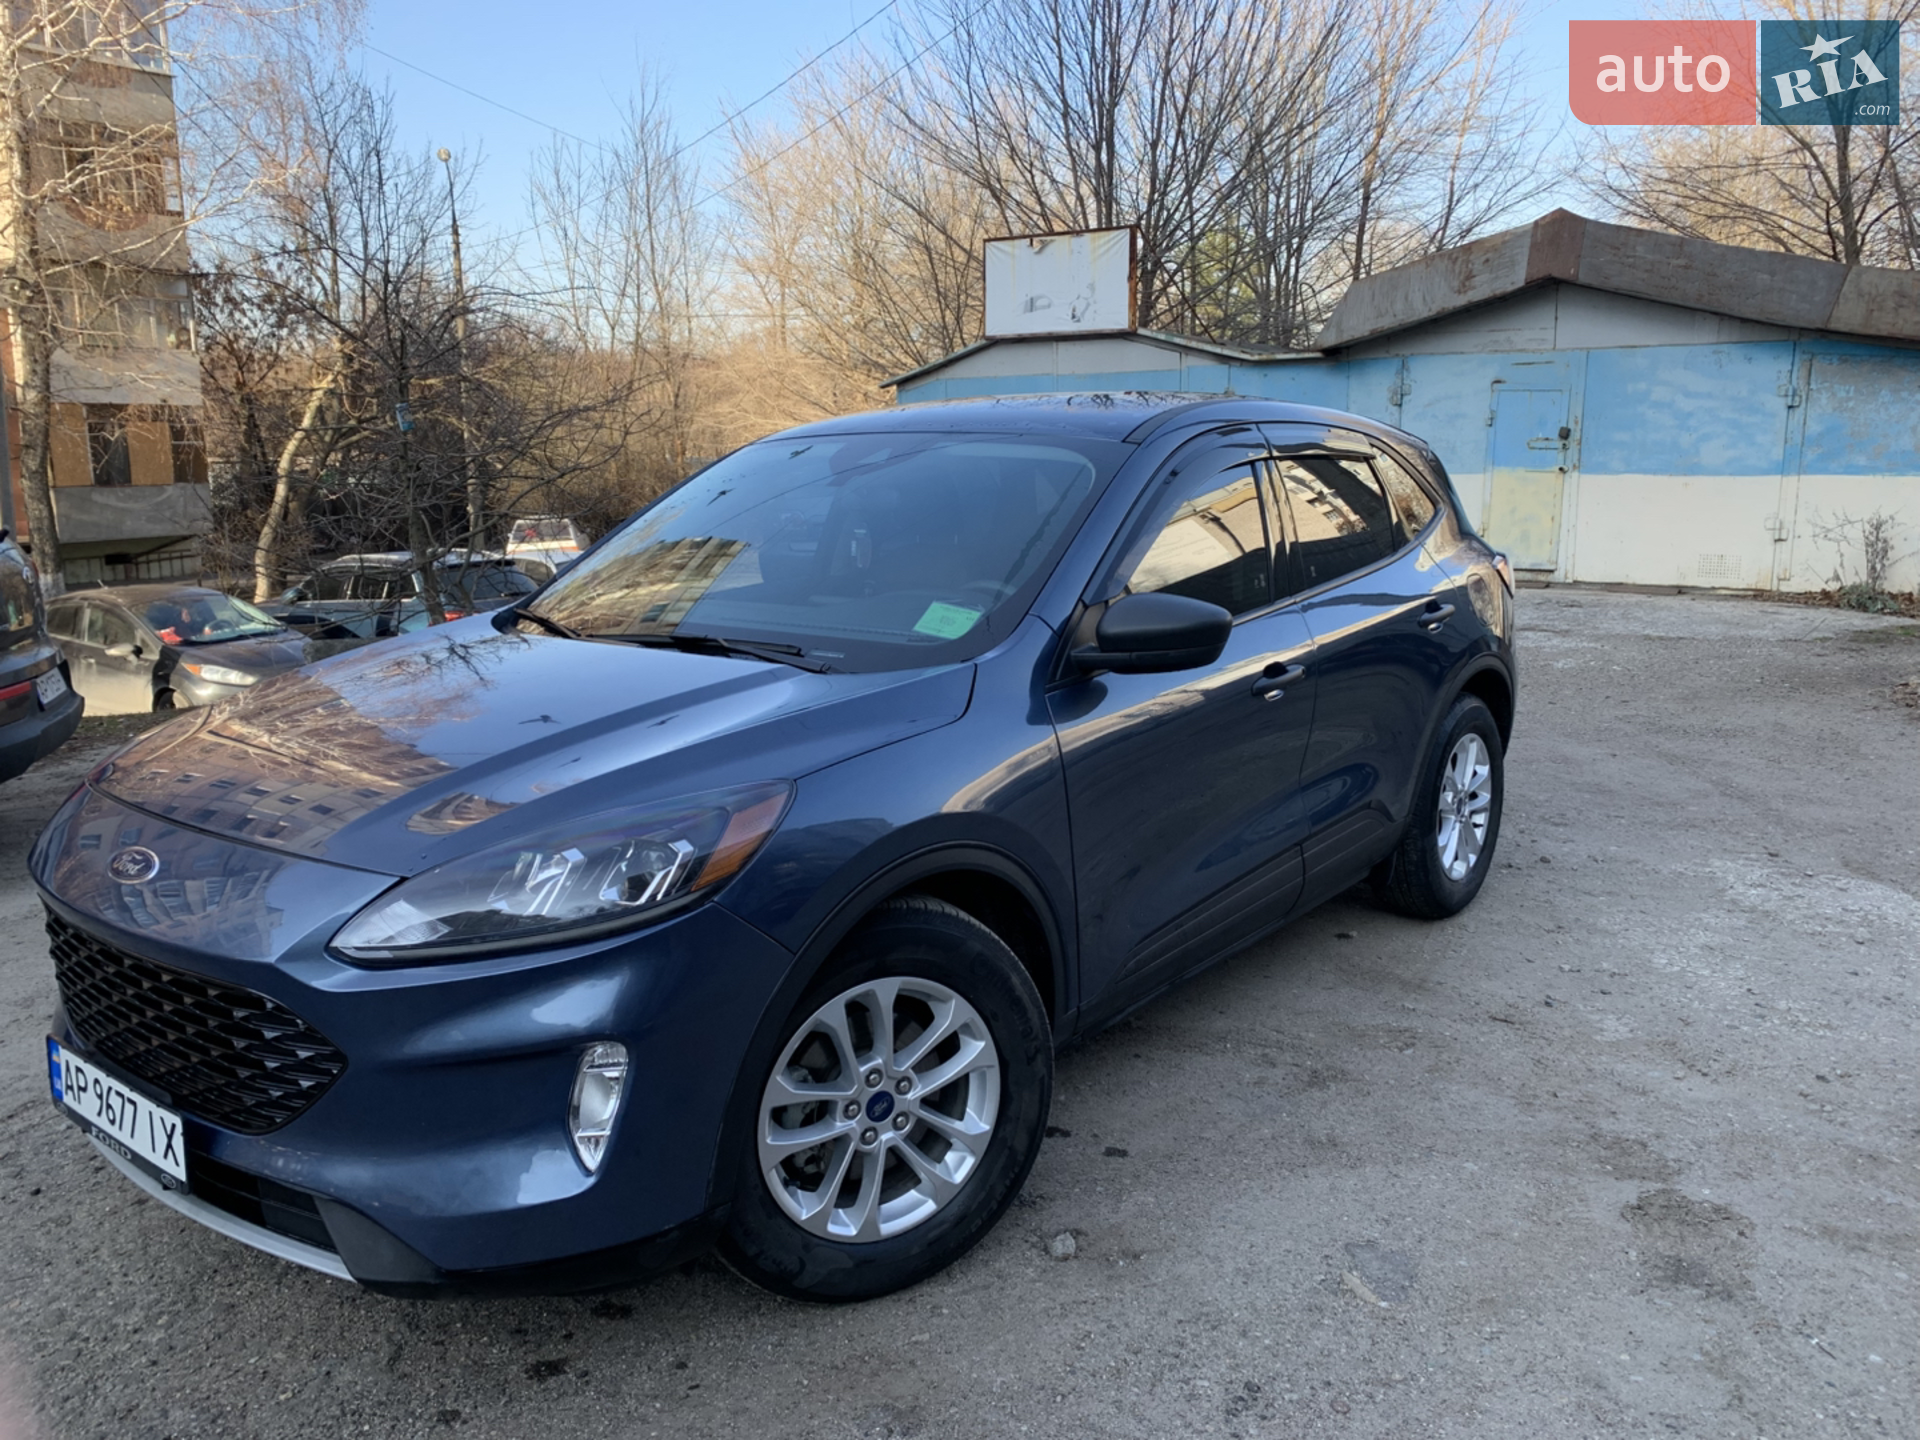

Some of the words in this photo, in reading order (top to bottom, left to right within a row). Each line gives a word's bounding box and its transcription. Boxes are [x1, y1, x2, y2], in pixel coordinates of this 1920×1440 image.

[65, 1060, 88, 1105] AP
[93, 1077, 137, 1140] 9677
[149, 1110, 180, 1168] IX
[91, 1126, 131, 1159] FORD
